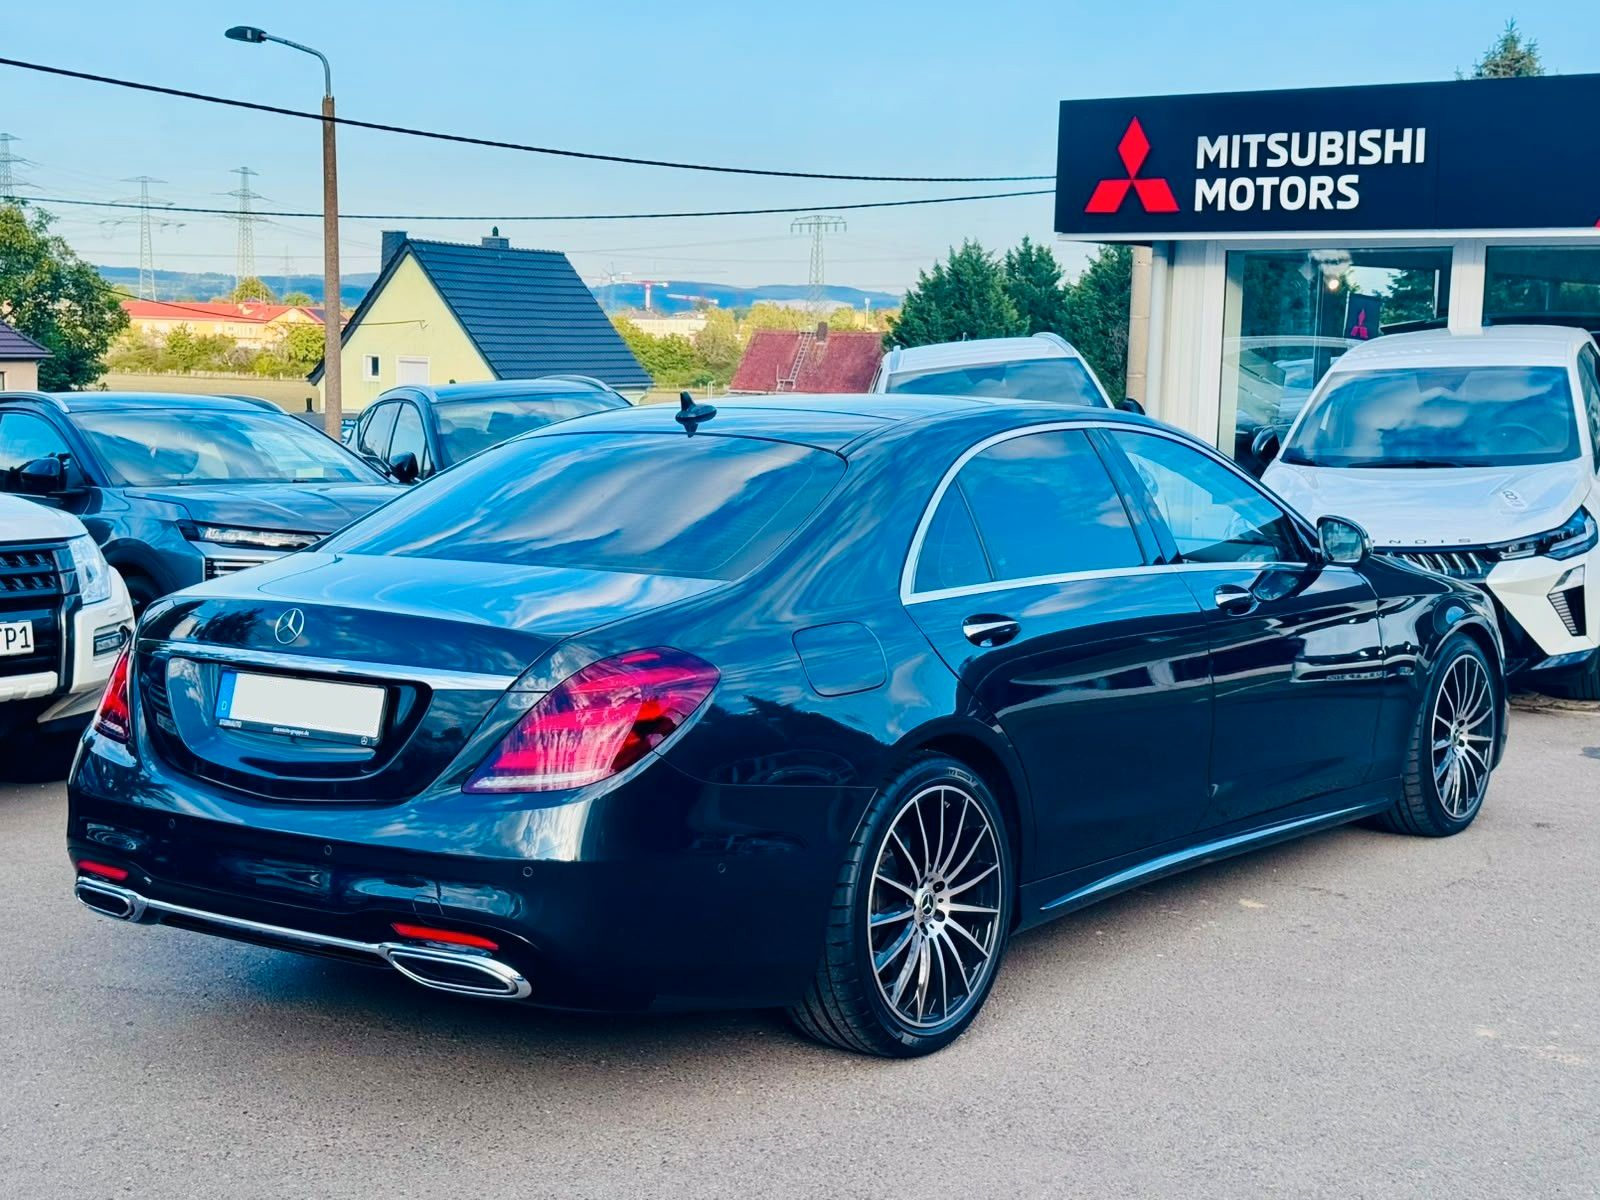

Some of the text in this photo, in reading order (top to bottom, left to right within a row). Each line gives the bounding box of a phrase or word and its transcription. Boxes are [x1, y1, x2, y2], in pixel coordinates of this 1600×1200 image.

[1196, 127, 1426, 169] MITSUBISHI
[1194, 174, 1361, 212] MOTORS
[0, 625, 31, 650] P1
